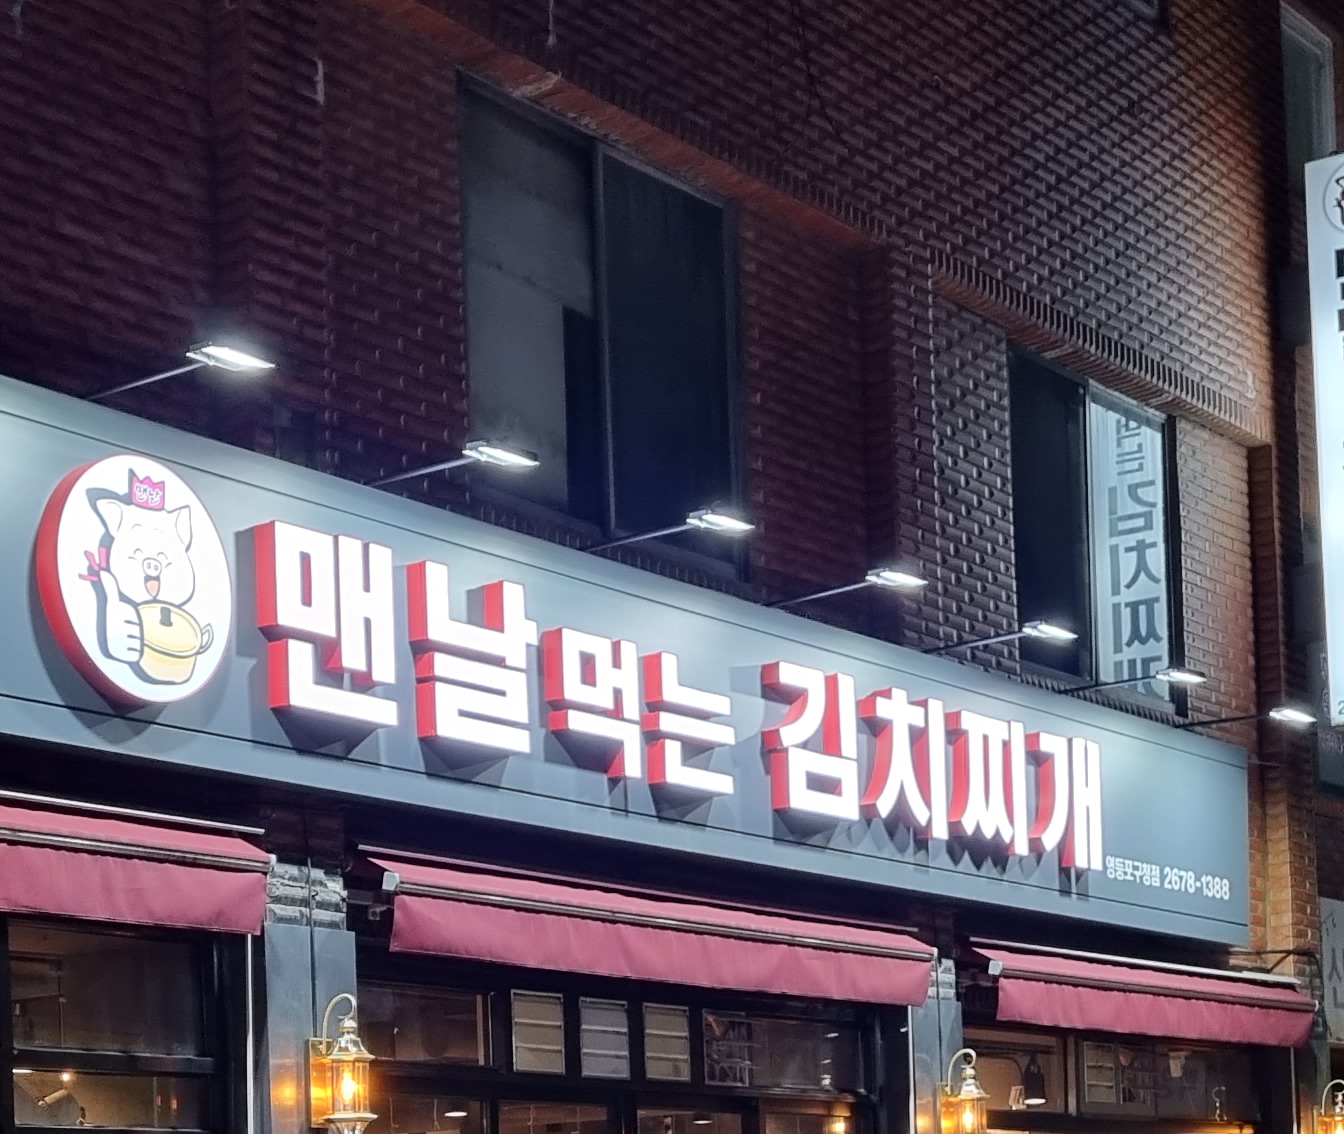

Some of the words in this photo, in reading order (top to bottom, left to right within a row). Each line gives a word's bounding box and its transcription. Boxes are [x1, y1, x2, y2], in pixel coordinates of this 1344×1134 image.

[134, 483, 164, 505] 맨날
[254, 519, 539, 755] 맨날
[541, 626, 737, 796] 먹는
[760, 660, 1104, 872] 김치찌개
[1105, 854, 1160, 888] 영등포구청점
[1163, 865, 1230, 900] 2678-1388
